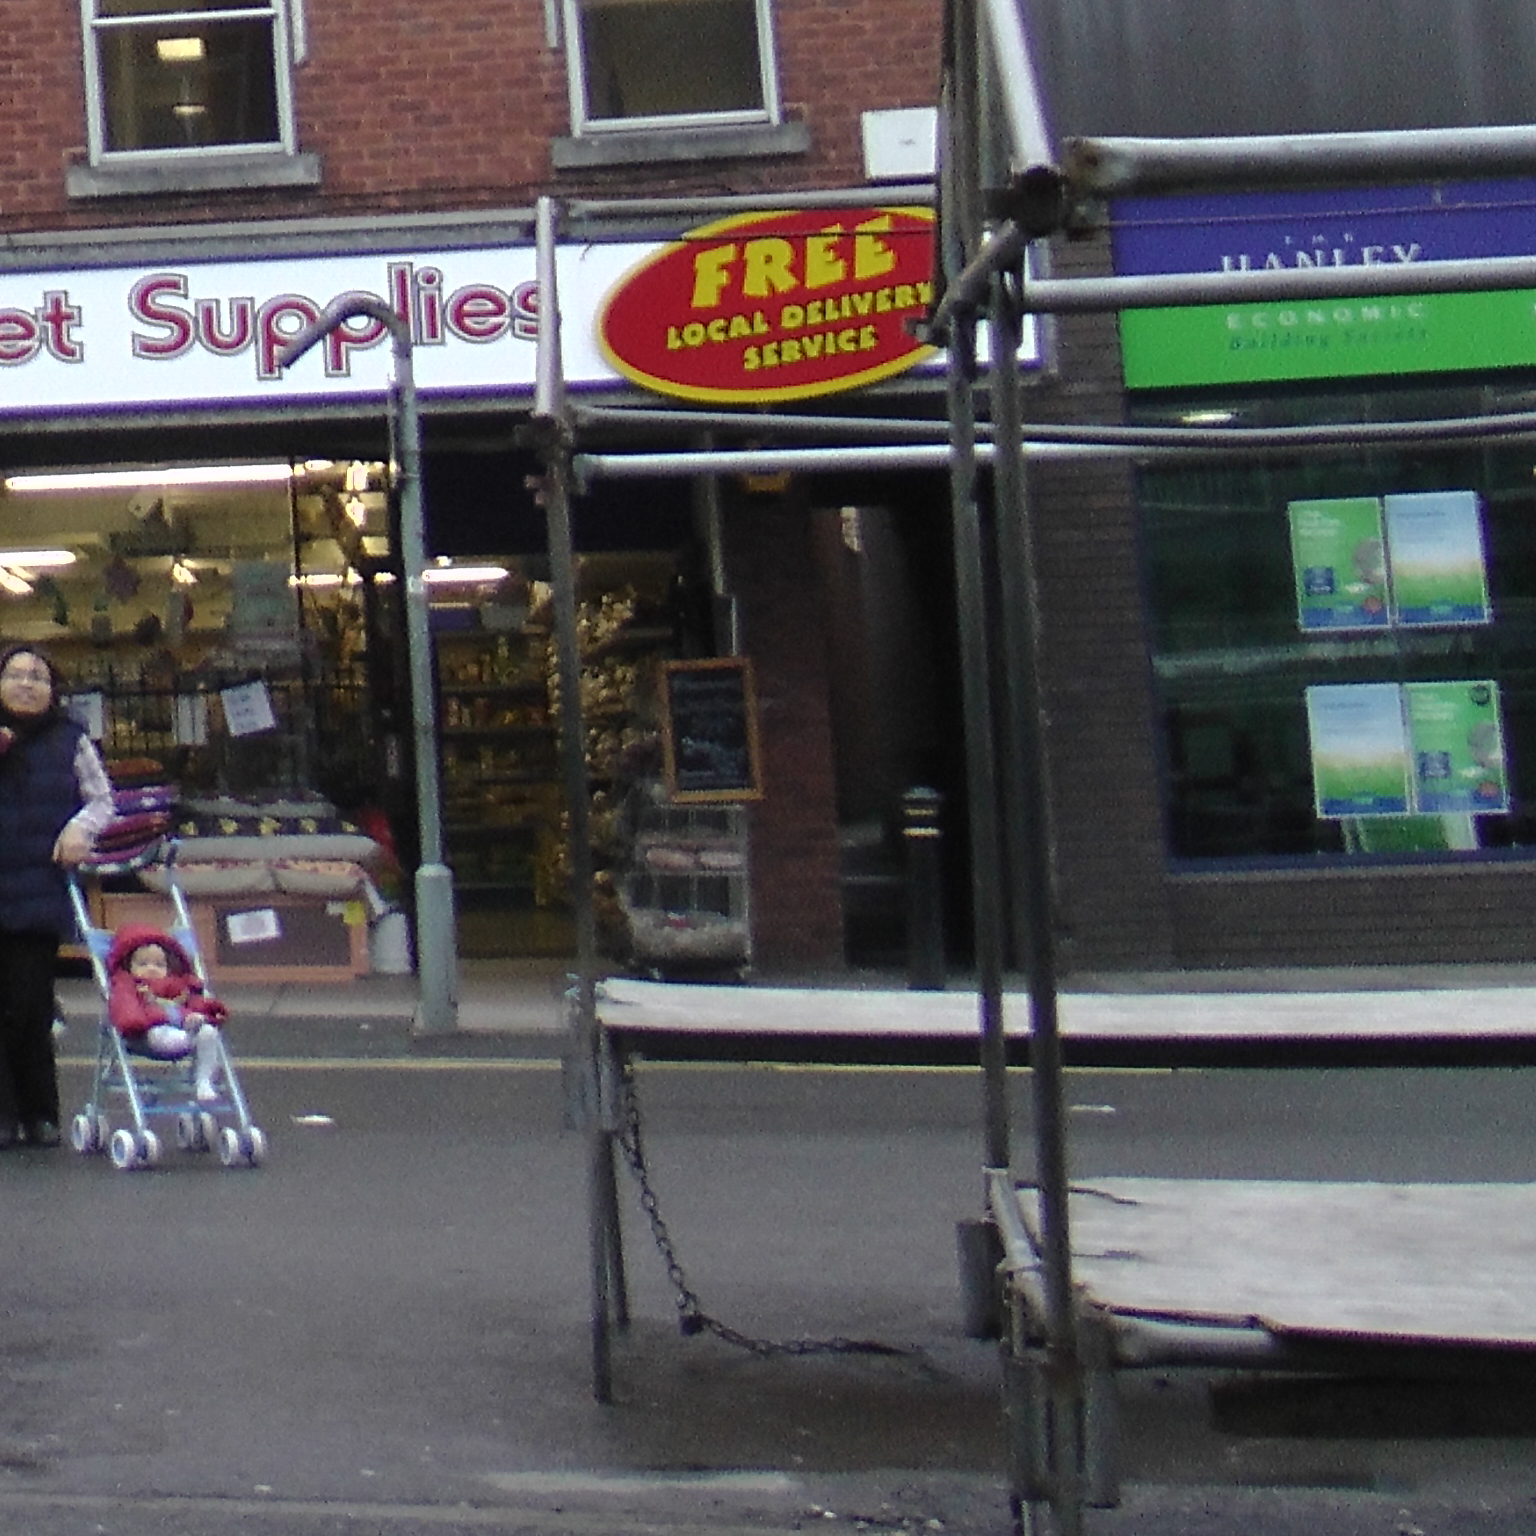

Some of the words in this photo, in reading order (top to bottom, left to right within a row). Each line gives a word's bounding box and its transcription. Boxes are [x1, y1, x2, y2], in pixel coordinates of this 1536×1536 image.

[691, 215, 897, 308] FREE
[666, 310, 769, 350] LOCAL
[780, 280, 932, 329] DELIVERY
[1226, 300, 1424, 329] ECONOMIC
[743, 324, 876, 371] SERVICE
